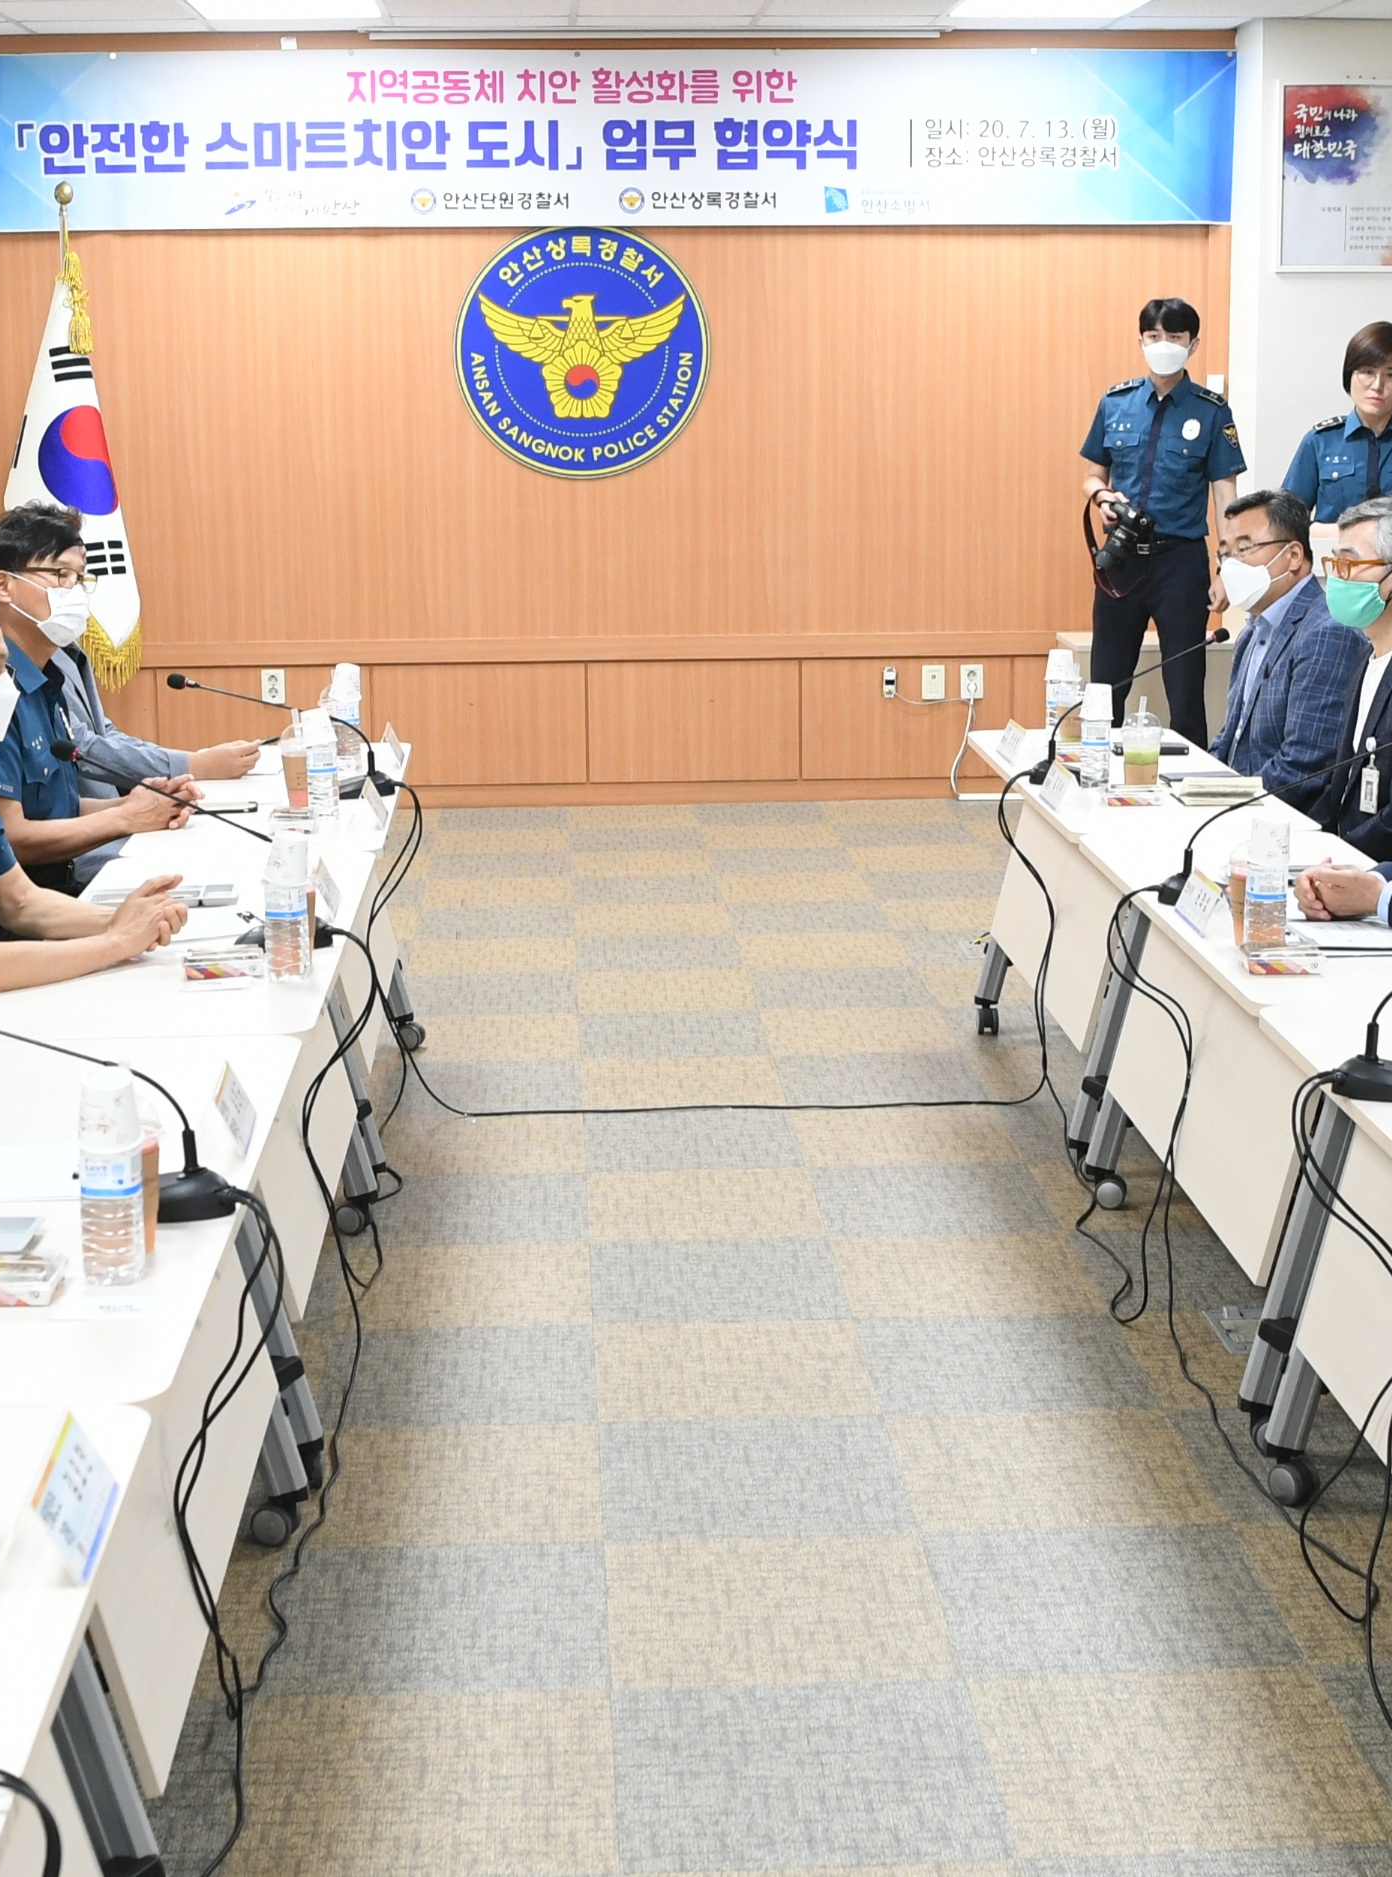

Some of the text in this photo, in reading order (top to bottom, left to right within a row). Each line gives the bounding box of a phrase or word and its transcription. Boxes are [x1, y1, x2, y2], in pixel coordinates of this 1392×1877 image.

[346, 68, 797, 105] 지역공동체 치안 활성화를 위한
[1293, 103, 1358, 123] 국민의 나라
[924, 118, 970, 141] 일시:
[1081, 117, 1119, 141] (월)
[205, 118, 451, 173] 스마트치안
[601, 117, 696, 171] 업무
[714, 117, 859, 171] 협약식
[924, 145, 1120, 169] 장소: 안산상록경찰서
[1293, 139, 1357, 161] 대한민국
[443, 191, 569, 211] 안산단원경찰서
[651, 190, 777, 210] 안산상록경찰서
[861, 199, 930, 214] 안산소방서
[498, 235, 665, 289] 안산상록경찰서
[469, 351, 694, 463] ANSAN SANGNOK POLICE STATION
